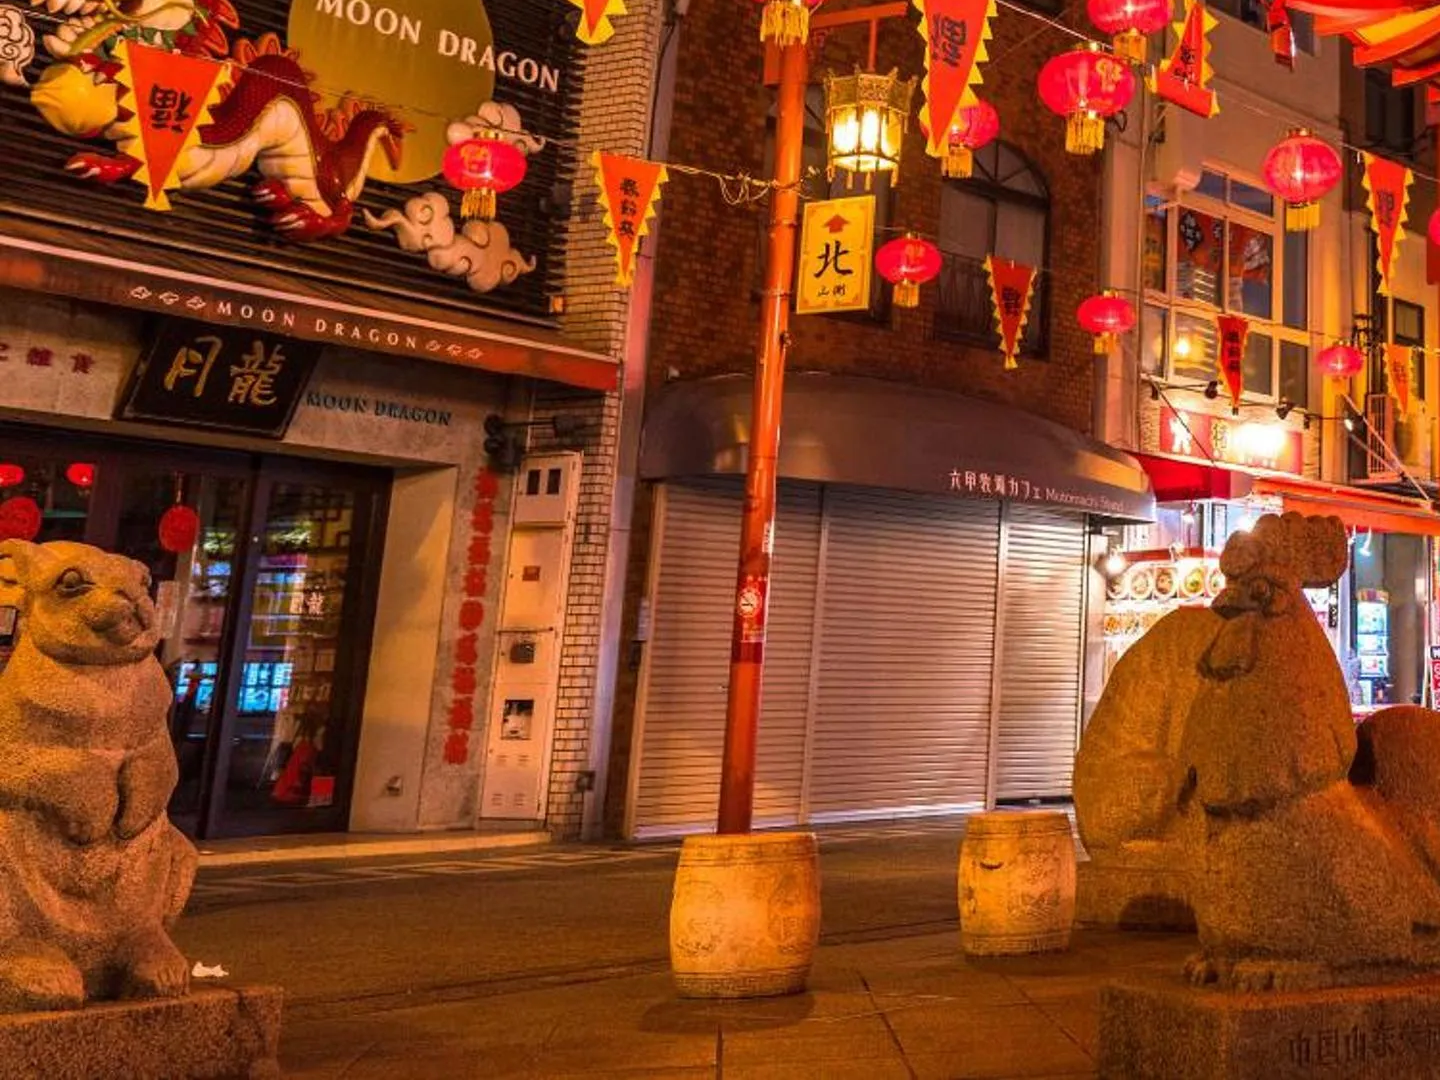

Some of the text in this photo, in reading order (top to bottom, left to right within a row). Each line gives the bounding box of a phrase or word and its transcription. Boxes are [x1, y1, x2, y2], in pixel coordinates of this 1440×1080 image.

[437, 29, 560, 93] DRAGON
[813, 240, 854, 279] 北
[217, 301, 418, 350] MOON DRAGON
[163, 336, 287, 407] 月龍
[307, 392, 452, 427] MOON DRAGON
